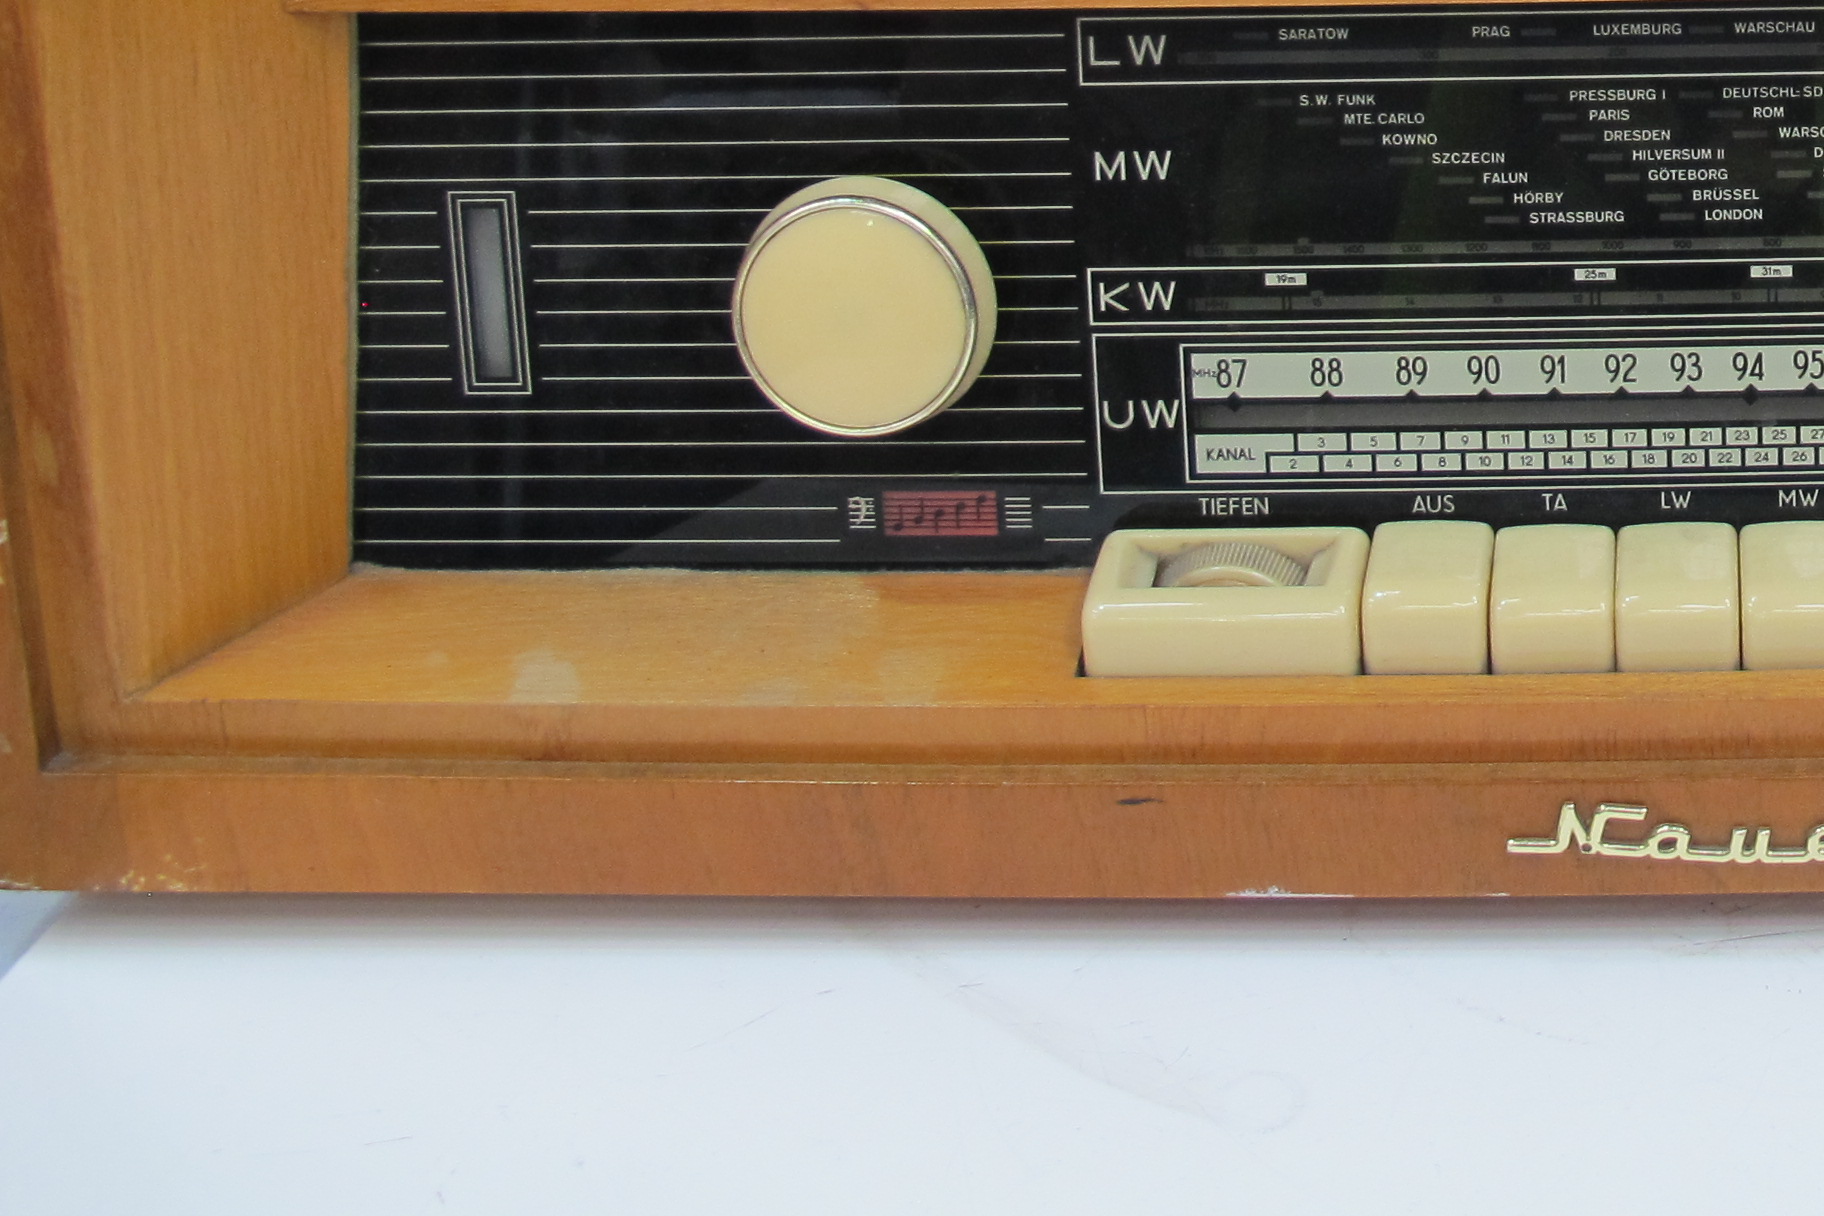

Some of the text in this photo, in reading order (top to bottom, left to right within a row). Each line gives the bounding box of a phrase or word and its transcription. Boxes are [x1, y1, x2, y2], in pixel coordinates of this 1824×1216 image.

[1472, 26, 1510, 37] PRAG
[1593, 23, 1682, 36] LUXEMBURG
[1734, 21, 1815, 34] WARSCHAU
[1278, 28, 1349, 41] SARATOW
[1089, 34, 1167, 67] LW
[1337, 94, 1376, 105] FUNK
[1569, 89, 1656, 102] PRESSBURG
[1378, 112, 1425, 124] CARLO
[1589, 109, 1630, 121] PARIS
[1753, 107, 1784, 119] ROM
[1382, 133, 1438, 145] KOWNO
[1603, 130, 1671, 142] DRESDEN
[1432, 152, 1505, 165] SZCZECIN
[1632, 149, 1725, 161] HILVERSUM II
[1094, 150, 1172, 181] MW
[1483, 172, 1528, 183] FALUN
[1648, 168, 1728, 181] GÖTEBORG
[1513, 191, 1563, 204] HÖRBY
[1693, 188, 1759, 201] BRÜSSEL
[1529, 211, 1625, 224] STRASSBURG
[1705, 209, 1763, 221] LONDON
[1762, 267, 1781, 276] 31m
[1099, 281, 1176, 311] KW
[1310, 357, 1344, 387] 88
[1396, 356, 1428, 386] 89
[1467, 355, 1500, 385] 90
[1540, 354, 1566, 384] 91
[1604, 353, 1638, 383] 92
[1669, 352, 1702, 382] 93
[1732, 351, 1764, 381] 94
[1192, 368, 1217, 379] MHz
[1216, 359, 1247, 388] 87
[1102, 399, 1180, 429] UW
[1461, 435, 1469, 445] 9
[1501, 434, 1510, 444] 11
[1543, 434, 1555, 444] 13
[1583, 433, 1596, 443] 15
[1624, 432, 1637, 443] 17
[1662, 432, 1675, 442] 19
[1701, 431, 1713, 441] 21
[1735, 430, 1750, 441] 23
[1772, 429, 1787, 440] 25
[1317, 438, 1325, 448] 3
[1370, 437, 1378, 447] 5
[1416, 436, 1425, 446] 7
[1206, 447, 1256, 461] KANAL
[1562, 455, 1573, 465] 14
[1603, 454, 1615, 465] 16
[1642, 454, 1655, 464] 18
[1681, 453, 1697, 464] 20
[1717, 452, 1733, 463] 22
[1754, 452, 1769, 462] 24
[1792, 451, 1807, 462] 26
[1290, 459, 1297, 470] 2
[1345, 458, 1353, 469] 4
[1394, 457, 1402, 468] 6
[1439, 457, 1446, 467] 8
[1479, 456, 1492, 467] 10
[1521, 456, 1533, 466] 12
[1412, 495, 1455, 513] AUS
[1542, 493, 1568, 511] TA
[1661, 491, 1691, 509] LW
[1779, 489, 1819, 508] MW
[1198, 497, 1270, 516] TIEFEN
